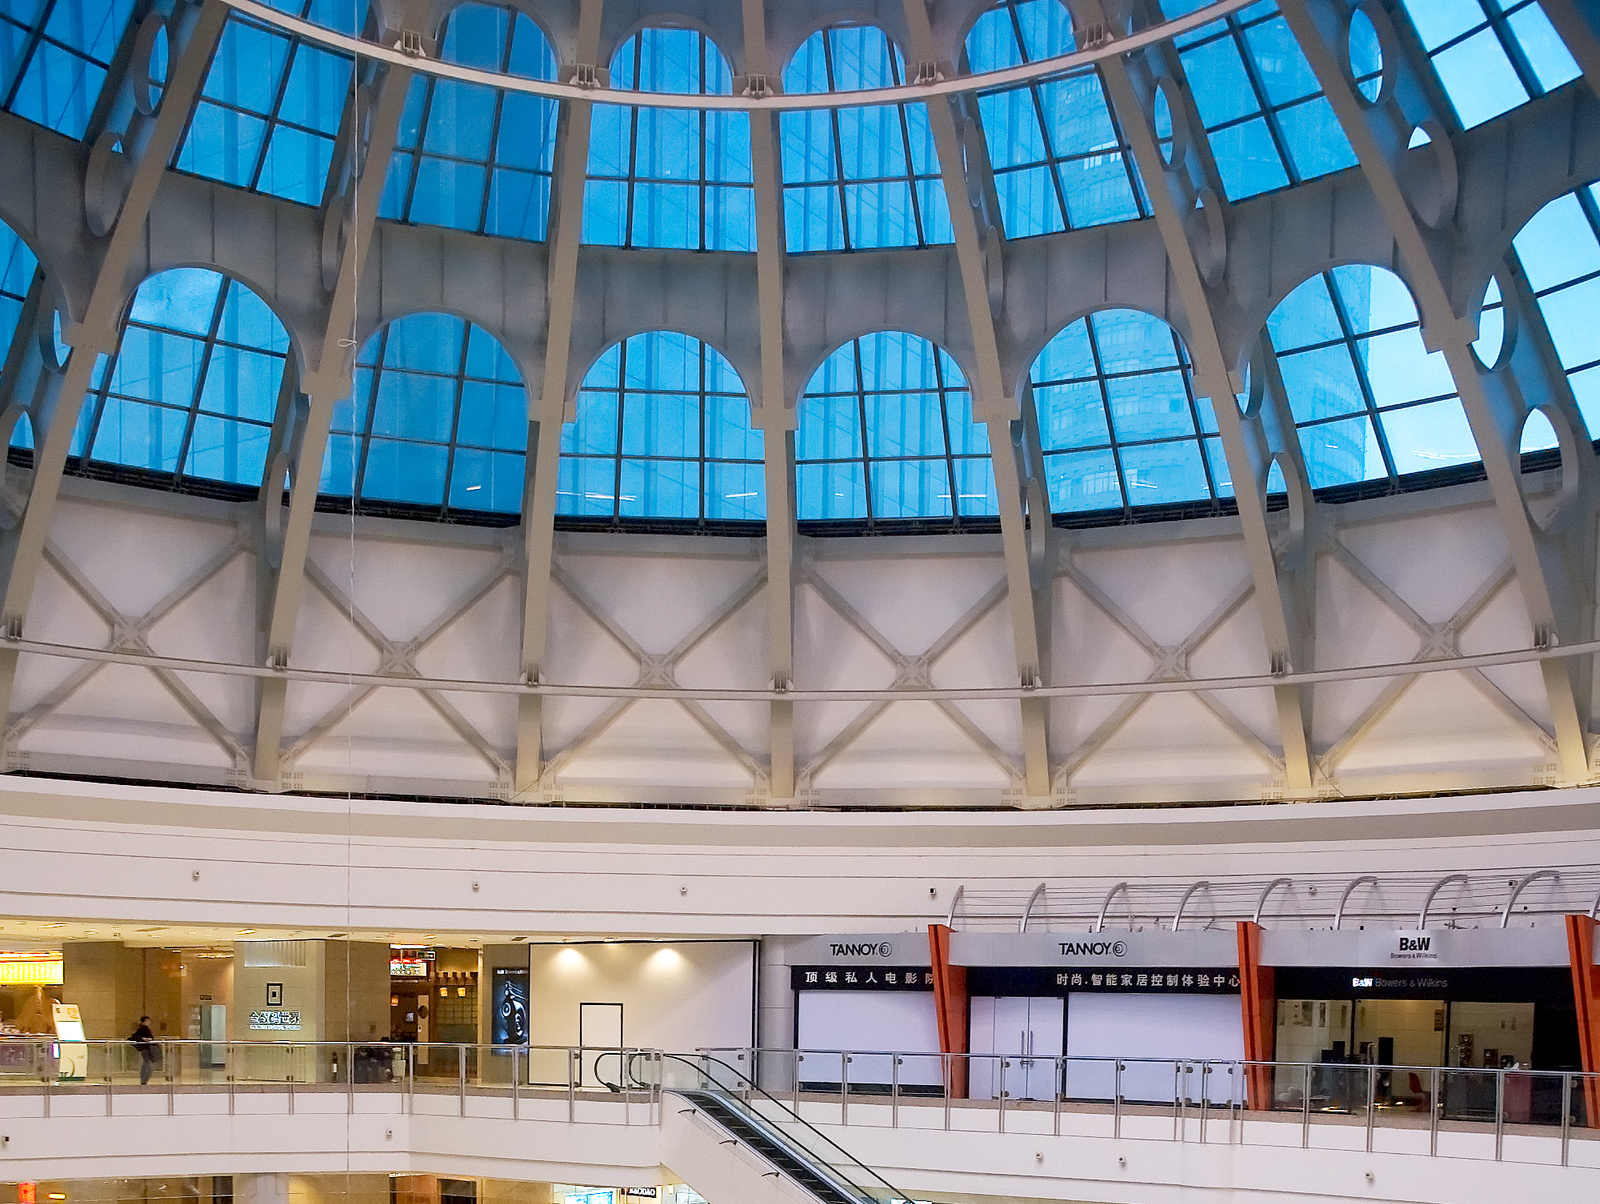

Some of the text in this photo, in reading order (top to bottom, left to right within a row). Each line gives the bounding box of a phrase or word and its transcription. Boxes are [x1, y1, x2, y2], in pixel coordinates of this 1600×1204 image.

[830, 943, 878, 956] TANNOY
[1058, 942, 1112, 956] TANNOY
[1399, 937, 1431, 951] B&W
[805, 971, 935, 984] 顶级私人电影院
[1352, 978, 1374, 988] B&W
[1375, 978, 1405, 988] Bowers
[1419, 978, 1448, 988] Wilkins
